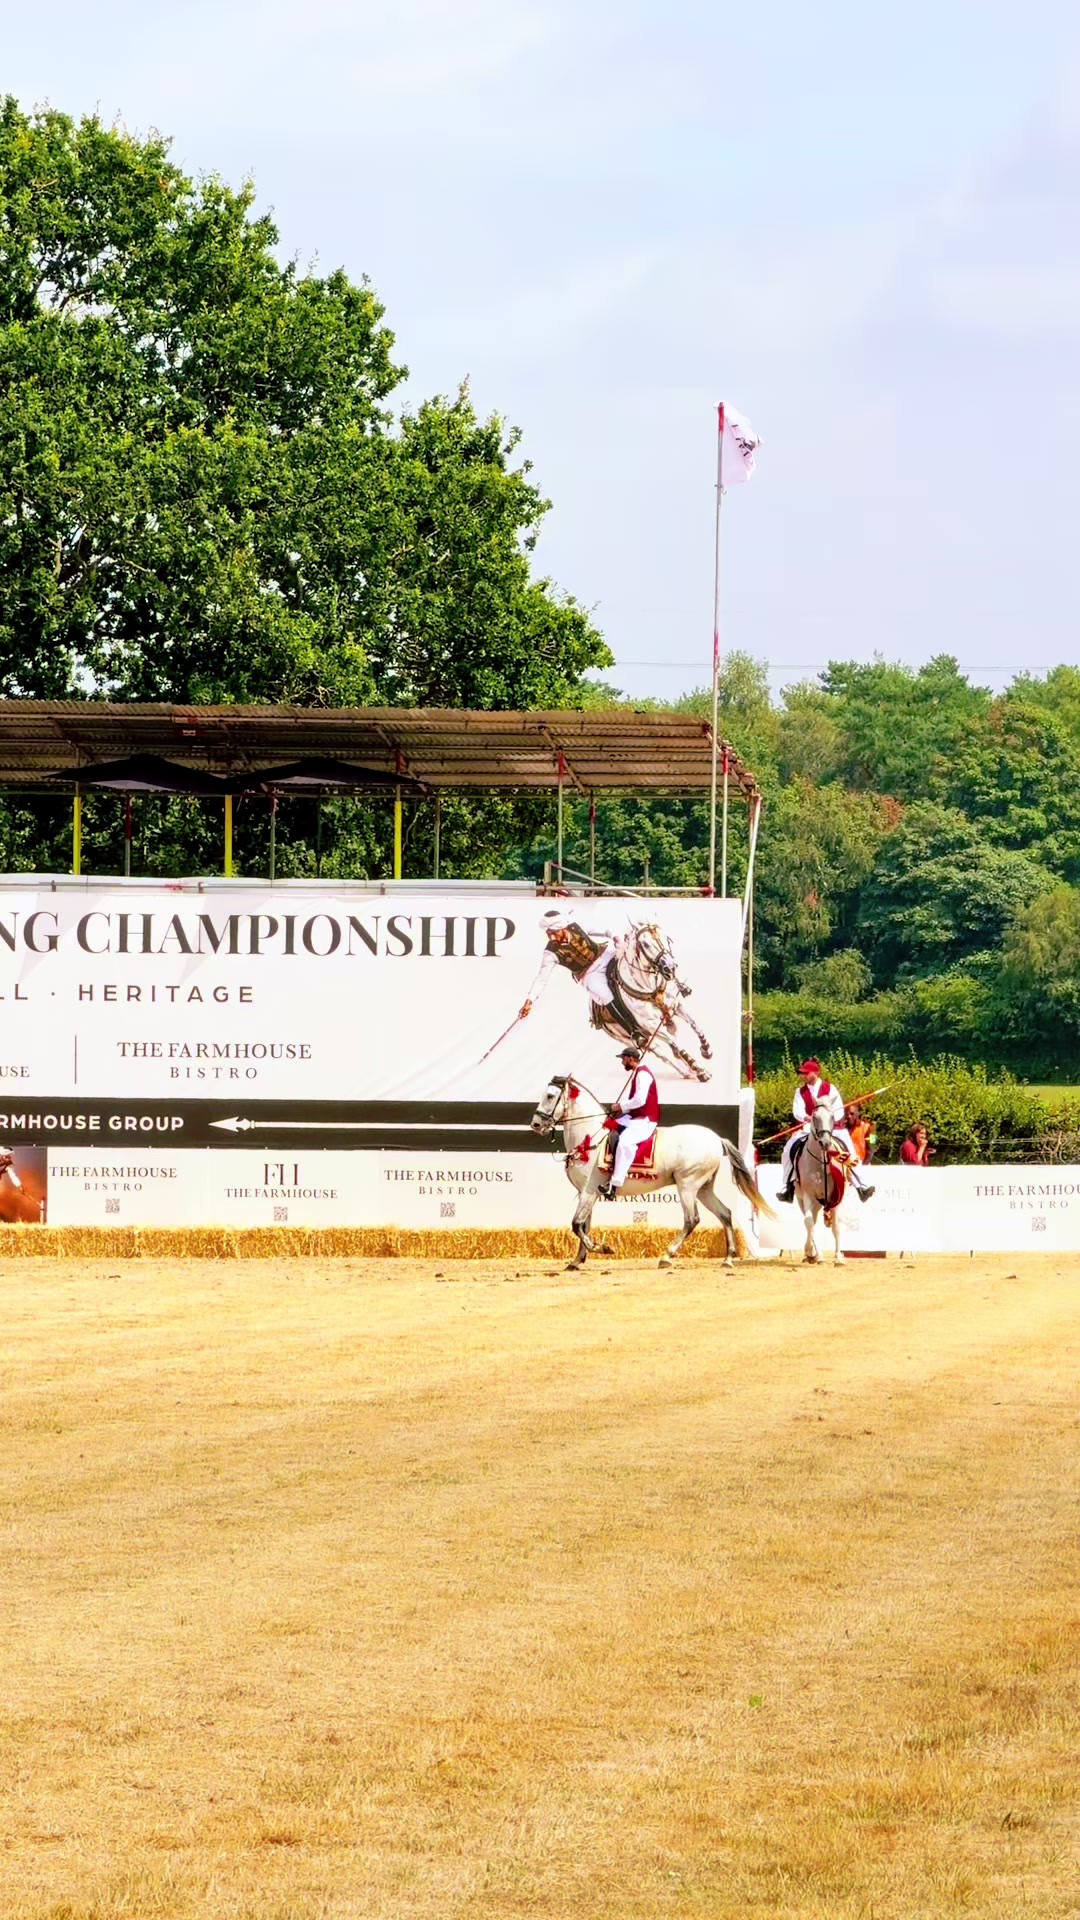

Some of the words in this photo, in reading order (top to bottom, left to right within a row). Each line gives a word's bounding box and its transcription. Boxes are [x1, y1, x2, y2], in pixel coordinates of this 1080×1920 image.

[76, 911, 516, 958] CHAMPIONSHIP
[78, 983, 254, 1004] HERITAGE
[116, 1041, 163, 1058] THE
[167, 1041, 312, 1060] FARMHOUSE
[170, 1066, 258, 1080] BISTRO
[108, 1115, 184, 1131] GROUP
[48, 1166, 81, 1178] THE
[83, 1166, 178, 1179] FARMHOUSE
[383, 1169, 416, 1182] THE
[417, 1169, 514, 1183] FARMHOUSE
[84, 1182, 143, 1192] BISTRO
[224, 1188, 252, 1198] THE
[254, 1188, 339, 1199] FARMHOUSE
[418, 1186, 478, 1196] BISTRO
[973, 1185, 1005, 1197] THE
[1009, 1200, 1069, 1210] BISTRO
